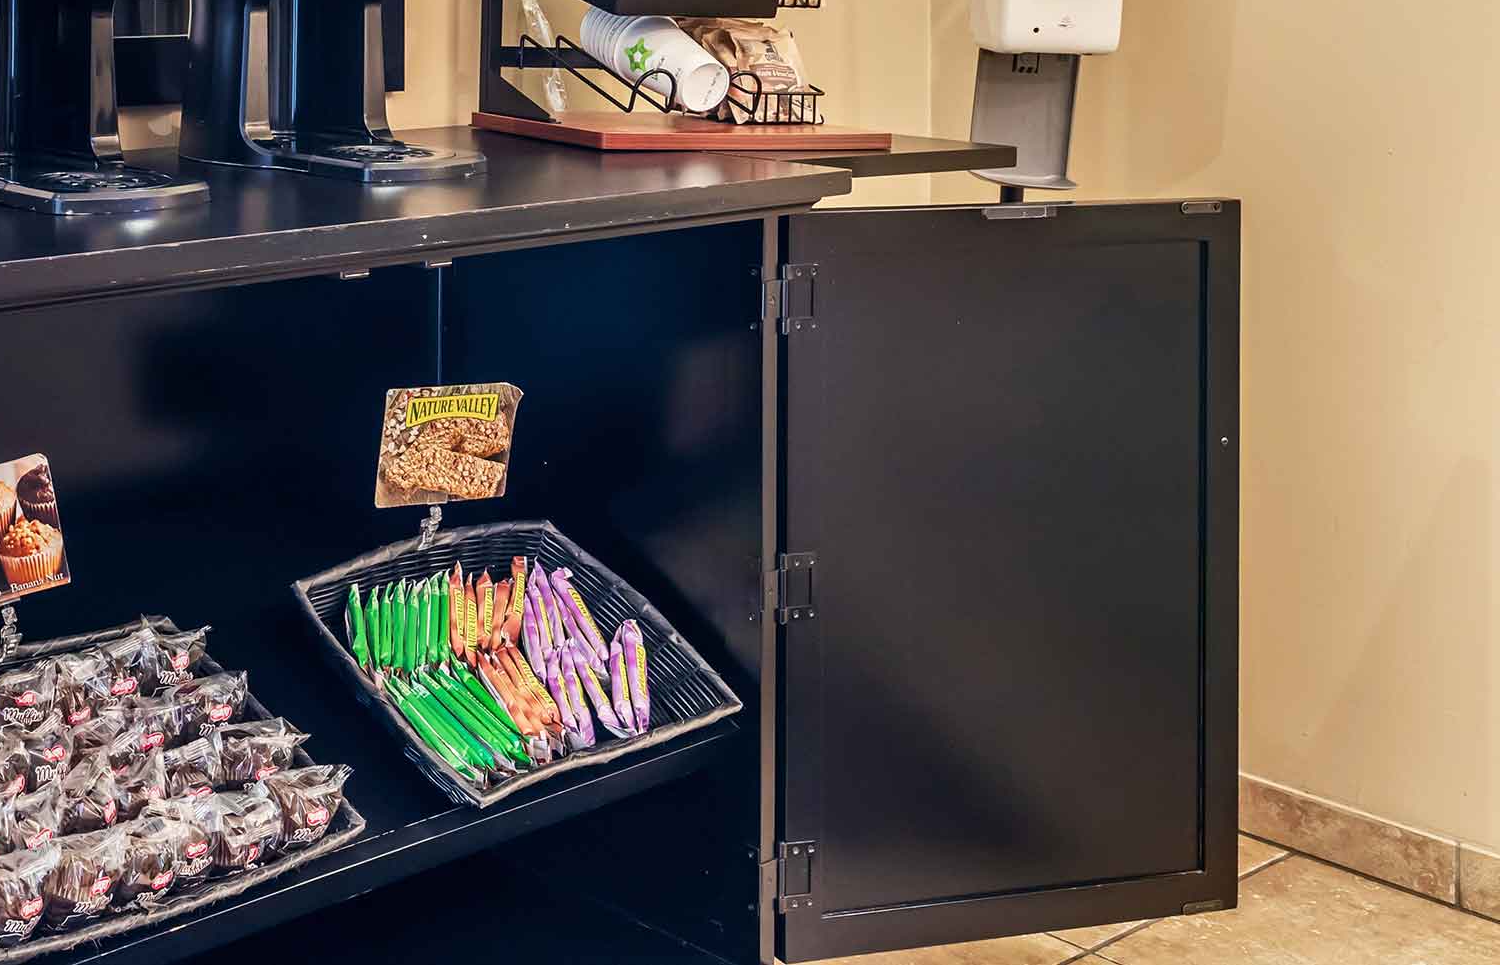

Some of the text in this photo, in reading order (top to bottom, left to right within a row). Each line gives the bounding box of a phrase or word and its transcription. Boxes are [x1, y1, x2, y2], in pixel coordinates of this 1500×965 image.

[410, 396, 496, 424] NATURE VALLEY
[10, 578, 45, 593] Banana
[45, 572, 64, 583] Nut
